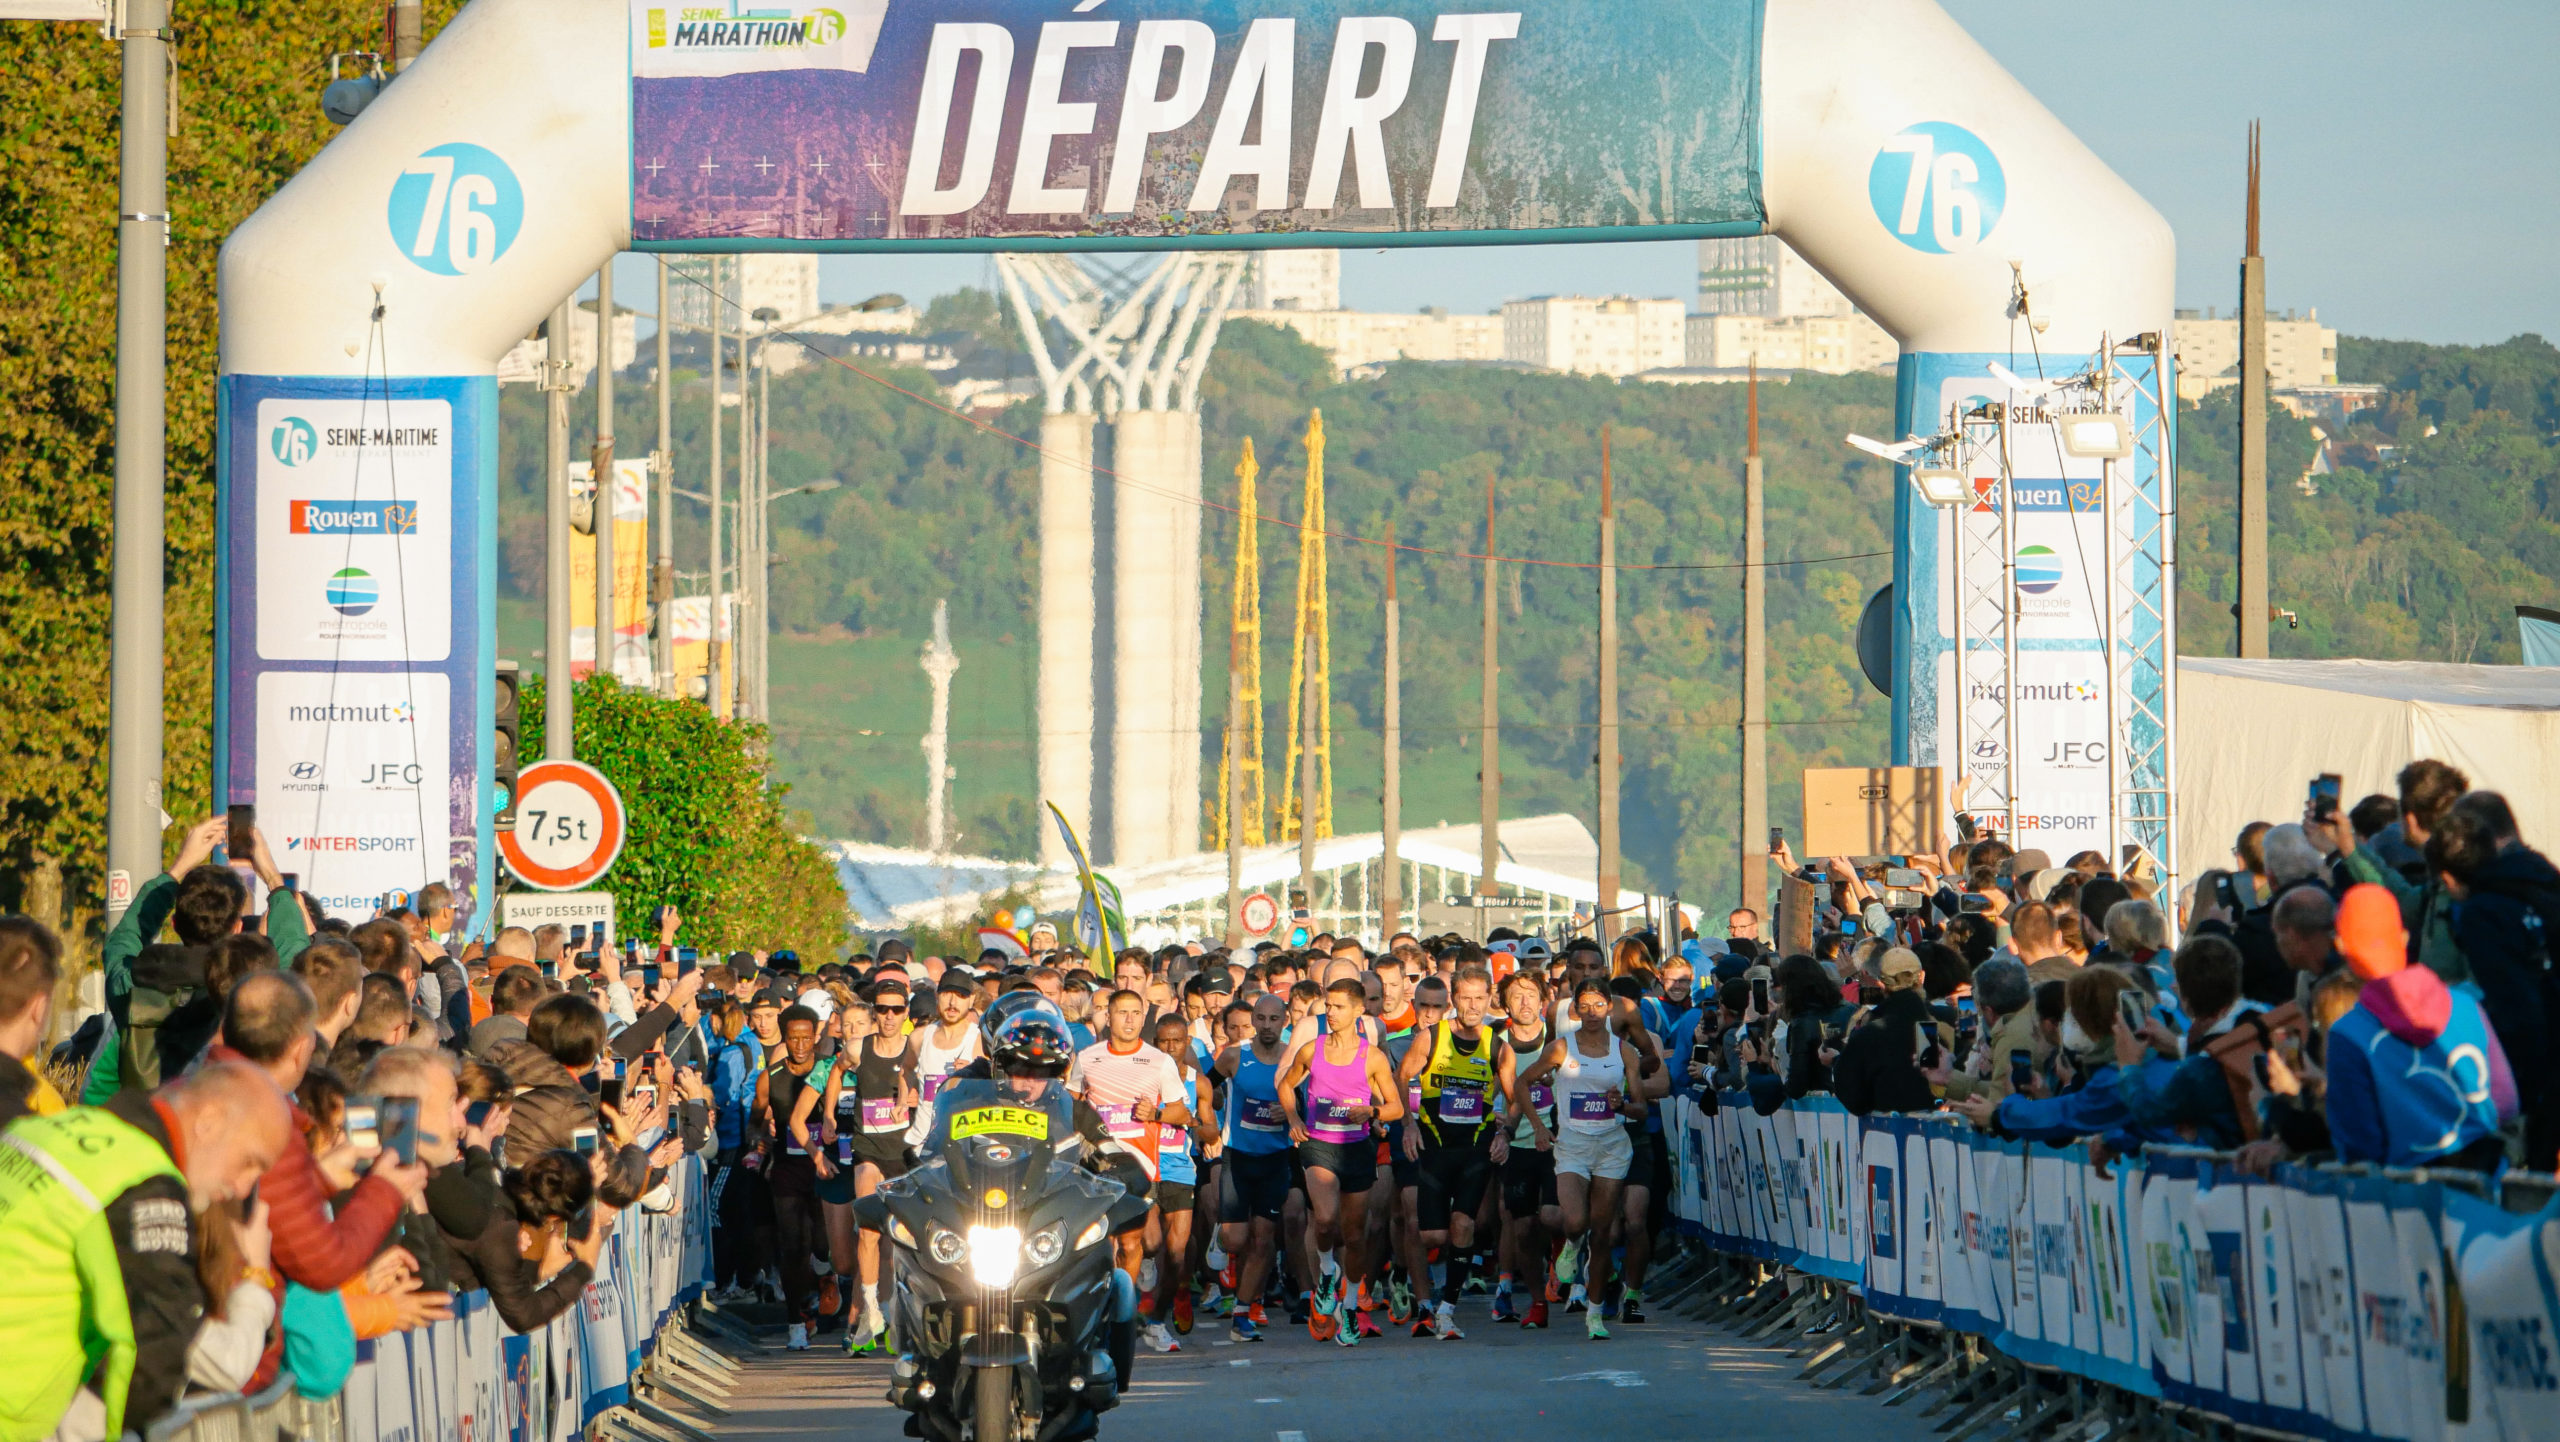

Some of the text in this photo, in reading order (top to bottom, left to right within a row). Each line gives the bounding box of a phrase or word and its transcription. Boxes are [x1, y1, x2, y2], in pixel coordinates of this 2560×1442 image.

[680, 8, 725, 21] SEINE
[674, 22, 807, 46] MARATHON
[899, 0, 1521, 217] DÉPART
[1880, 133, 1982, 253] 76
[400, 155, 498, 275] 76
[274, 421, 309, 467] 76
[327, 428, 438, 446] SEINE-MARITIME
[303, 506, 378, 532] Rouen
[290, 703, 391, 722] matmut
[2044, 742, 2106, 763] JFC
[361, 763, 424, 784] JFC
[282, 784, 329, 792] HYUNDAI
[1986, 815, 2097, 830] INERSPORT
[304, 836, 416, 851] INTERSPORT
[111, 878, 129, 900] FO
[511, 905, 608, 918] SAUF DESSERTE
[1453, 1097, 1476, 1110] 2052
[1583, 1101, 1607, 1112] 2033
[134, 1201, 187, 1220] ZERO
